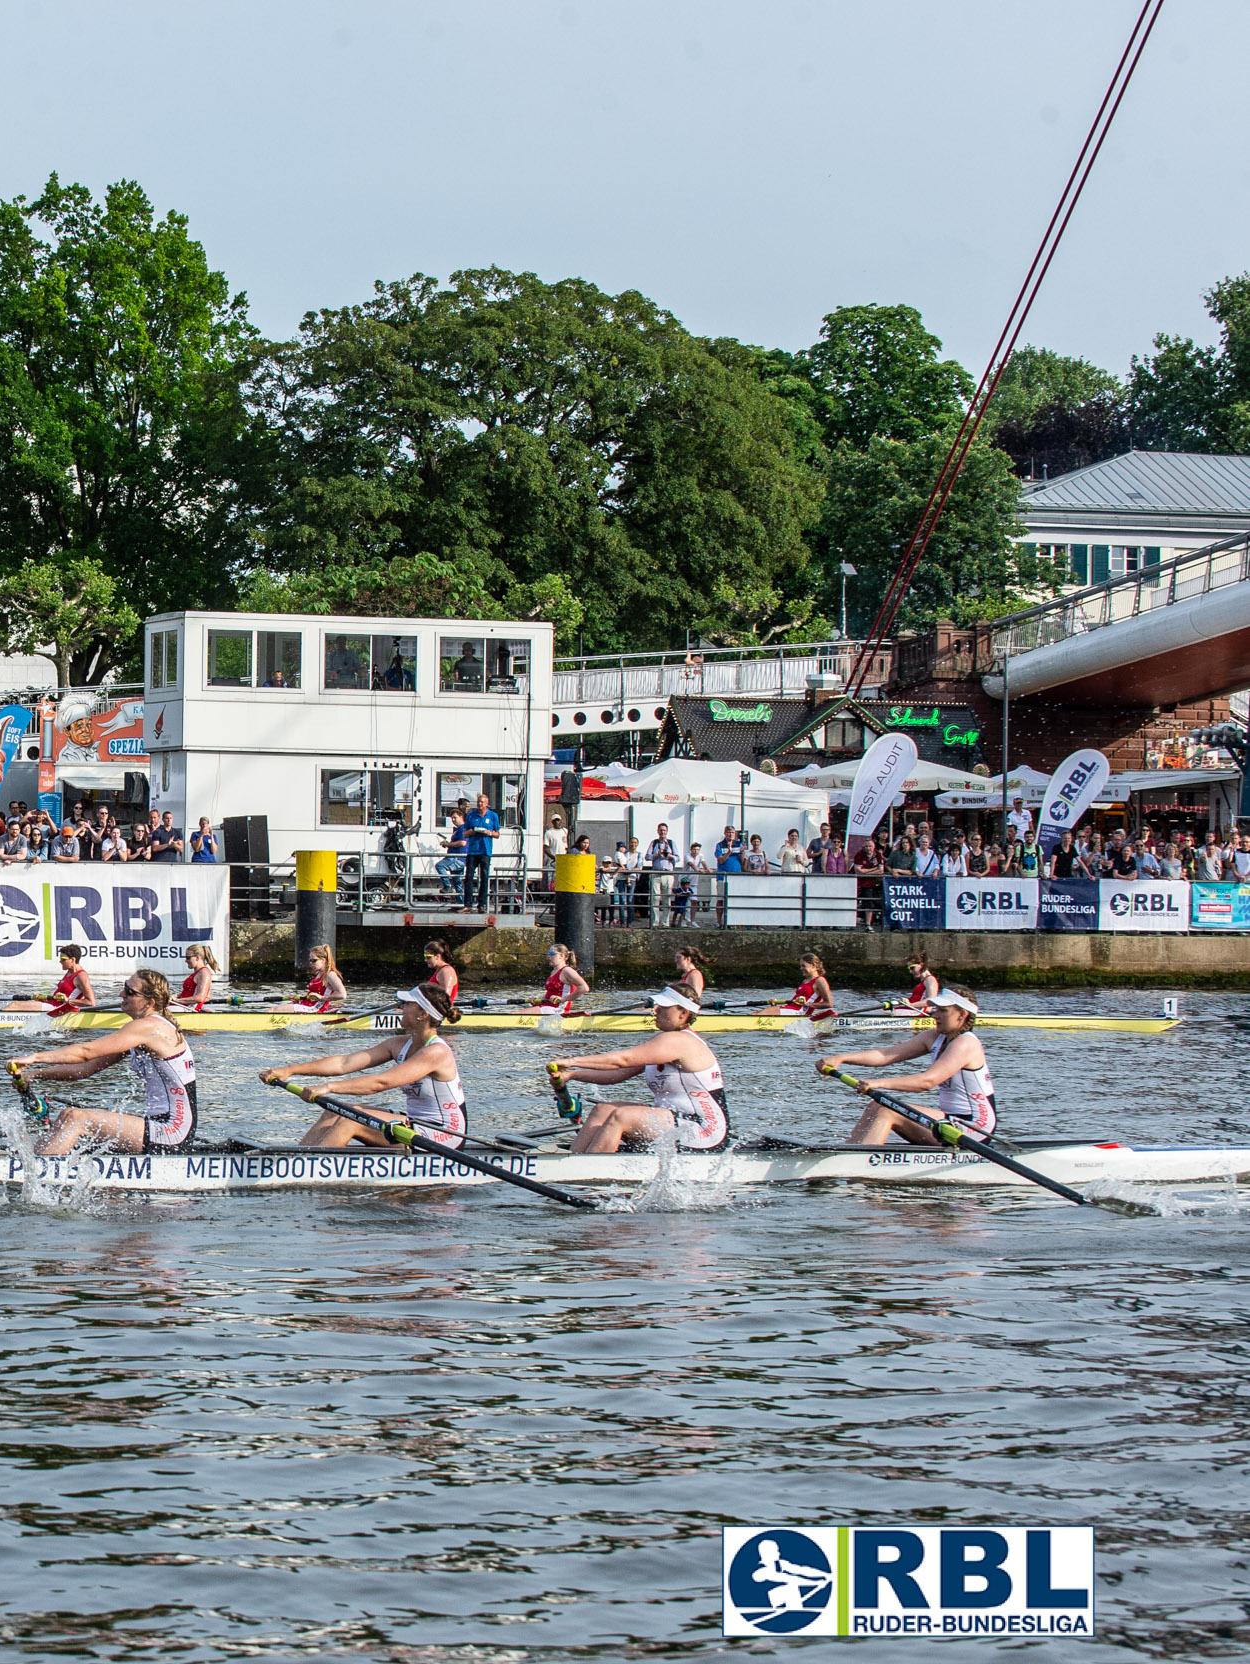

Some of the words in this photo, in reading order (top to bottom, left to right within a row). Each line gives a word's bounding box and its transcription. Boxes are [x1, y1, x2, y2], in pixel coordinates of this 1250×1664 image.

[709, 699, 773, 722] Drexel's
[885, 706, 940, 726] Schwenk
[7, 726, 22, 735] SOFT
[943, 724, 978, 746] Grill
[5, 734, 20, 745] EIS
[852, 786, 878, 826] BEST
[876, 742, 903, 786] AUDIT
[1059, 761, 1097, 801] RBL
[961, 796, 988, 805] BINDING
[888, 885, 927, 896] STARK.
[890, 898, 941, 909] SCHNELL.
[981, 891, 1029, 910] RBL
[1041, 894, 1074, 904] RUDER-
[1134, 893, 1179, 912] RBL
[53, 885, 214, 942] RBL
[1041, 904, 1096, 914] BUNDESLIGA
[890, 911, 915, 922] GUT.
[1166, 999, 1173, 1012] 1
[882, 1153, 910, 1164] RBL
